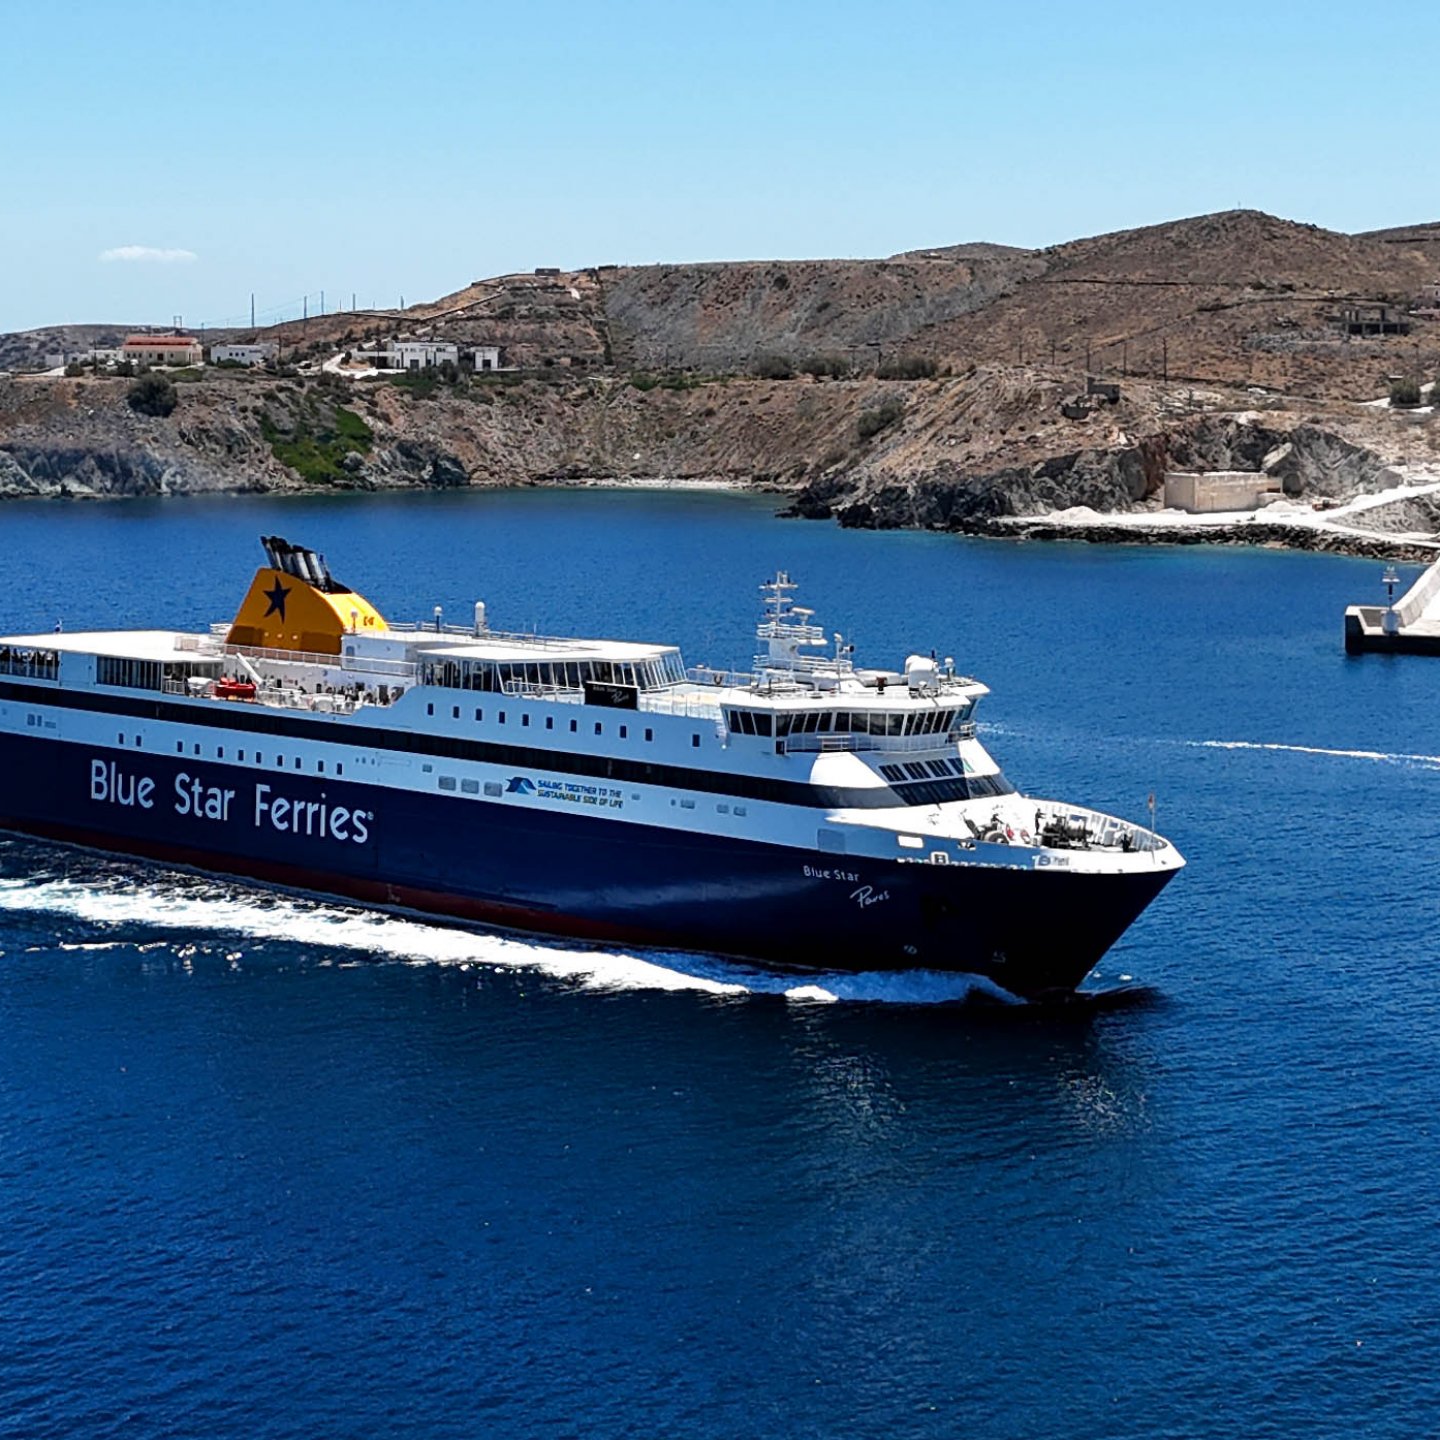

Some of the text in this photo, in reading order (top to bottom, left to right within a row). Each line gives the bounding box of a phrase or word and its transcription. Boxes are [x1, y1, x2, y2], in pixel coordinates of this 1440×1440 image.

[91, 759, 155, 808] Blue
[174, 772, 235, 821] Star
[537, 780, 622, 798] SAILING TOGETHER TO THE
[537, 789, 623, 809] SUSTAINABLE SIDE OF LIFE
[803, 865, 859, 882] Blue Star
[849, 885, 890, 909] Paros
